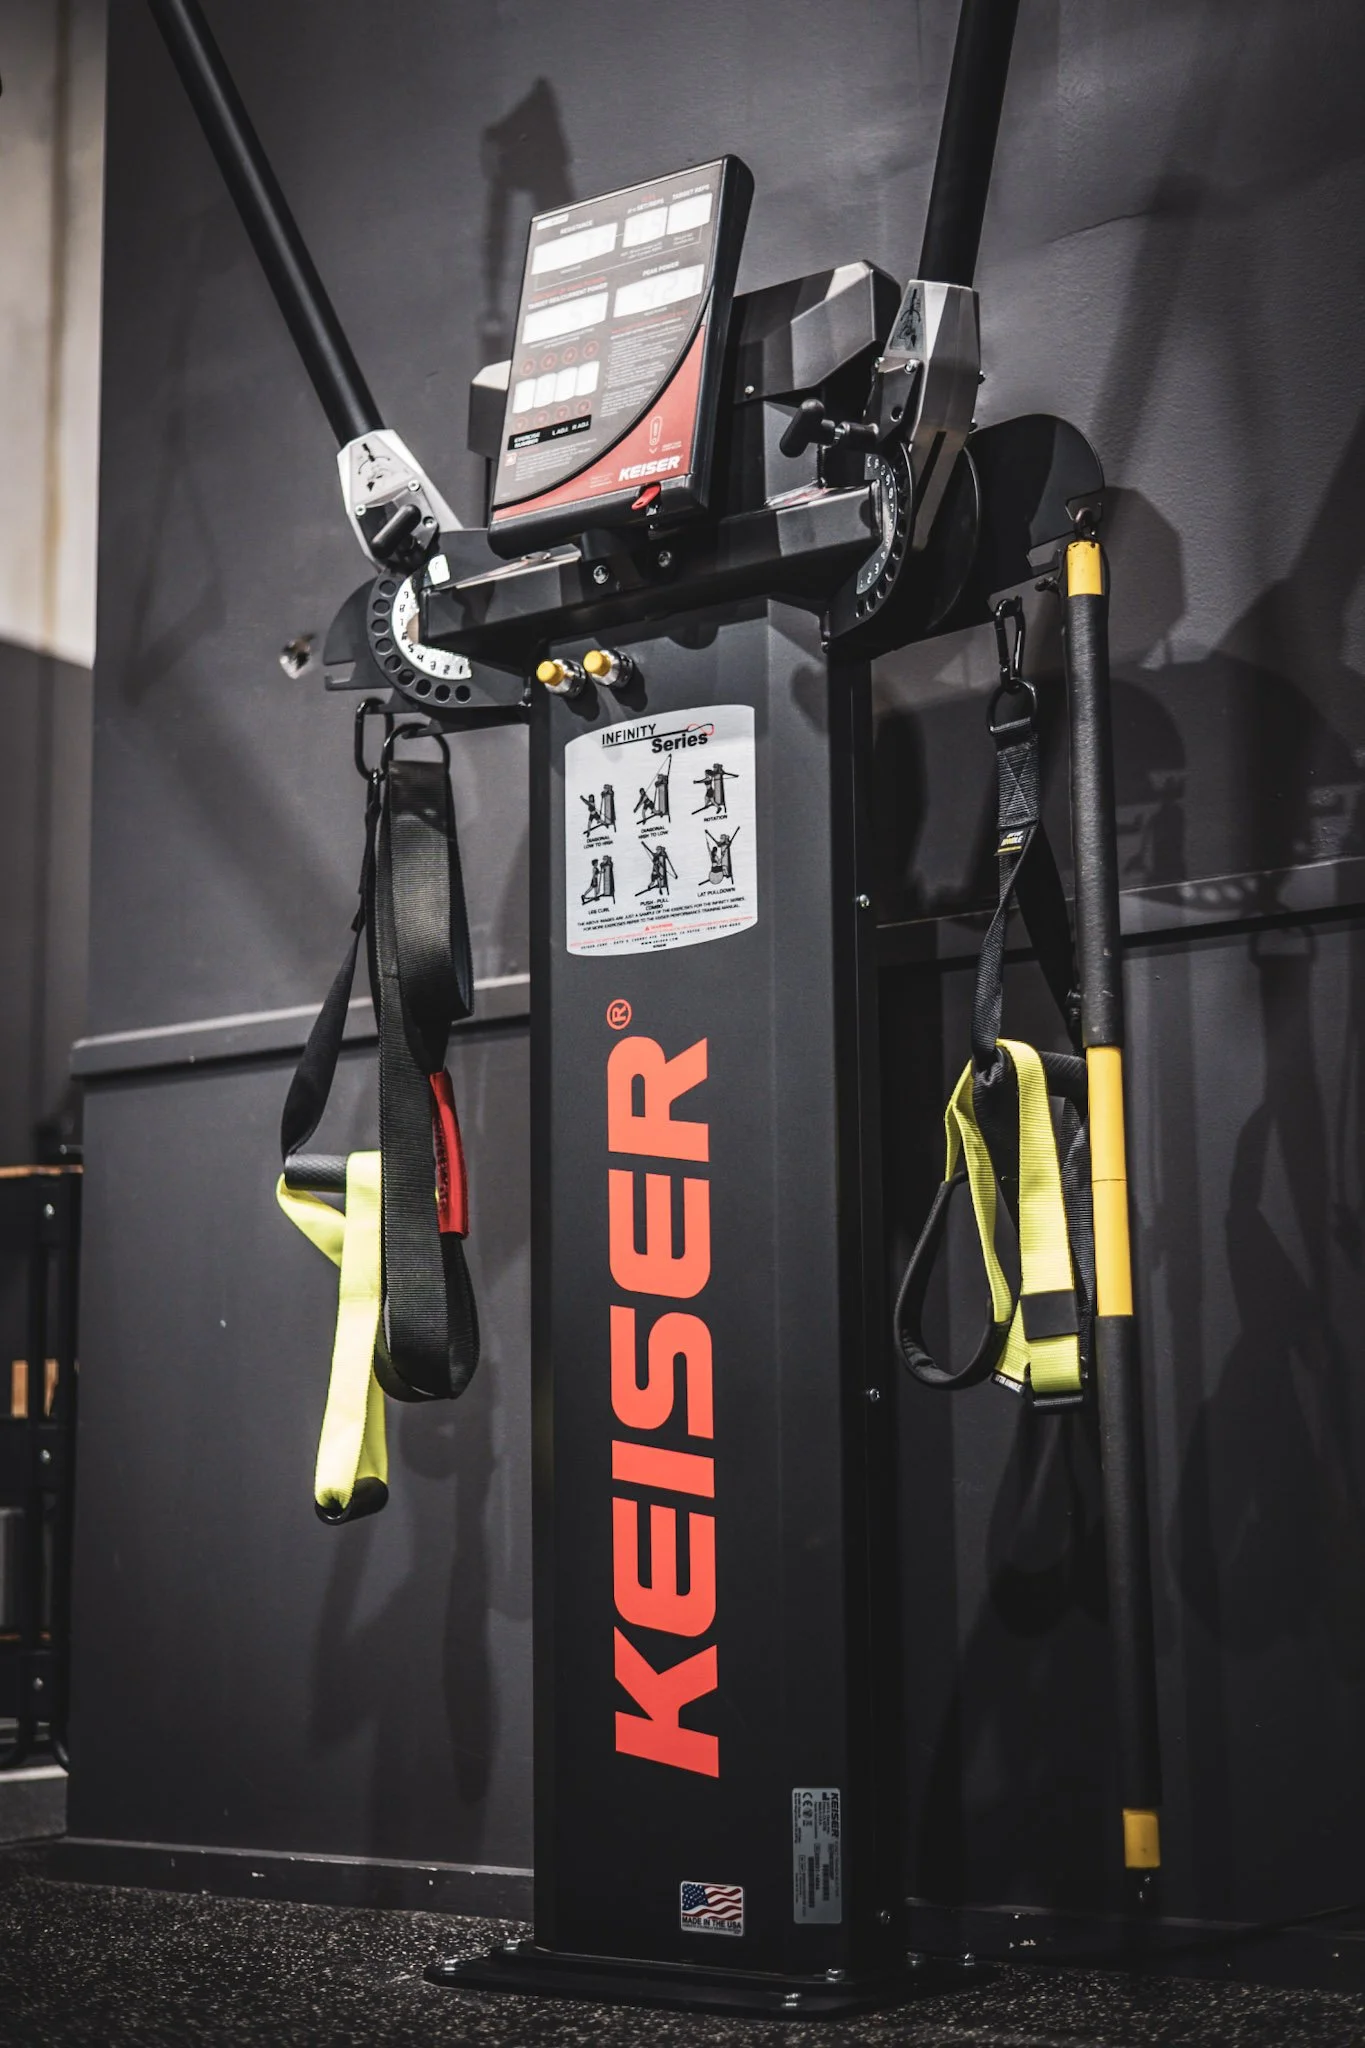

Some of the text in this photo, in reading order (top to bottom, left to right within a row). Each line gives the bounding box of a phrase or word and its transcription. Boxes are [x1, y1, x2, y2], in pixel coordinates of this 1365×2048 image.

[659, 260, 681, 273] POWER
[618, 455, 681, 481] KEISER
[601, 723, 657, 746] INFINITY
[651, 731, 709, 753] Series
[703, 814, 728, 822] ROTATION
[641, 825, 665, 834] DIAGONAL
[586, 835, 610, 843] DIAGONAL
[707, 887, 736, 896] PULLDOWN
[830, 1792, 839, 1838] KEISER
[682, 1916, 742, 1929] MADE IN THE USA
